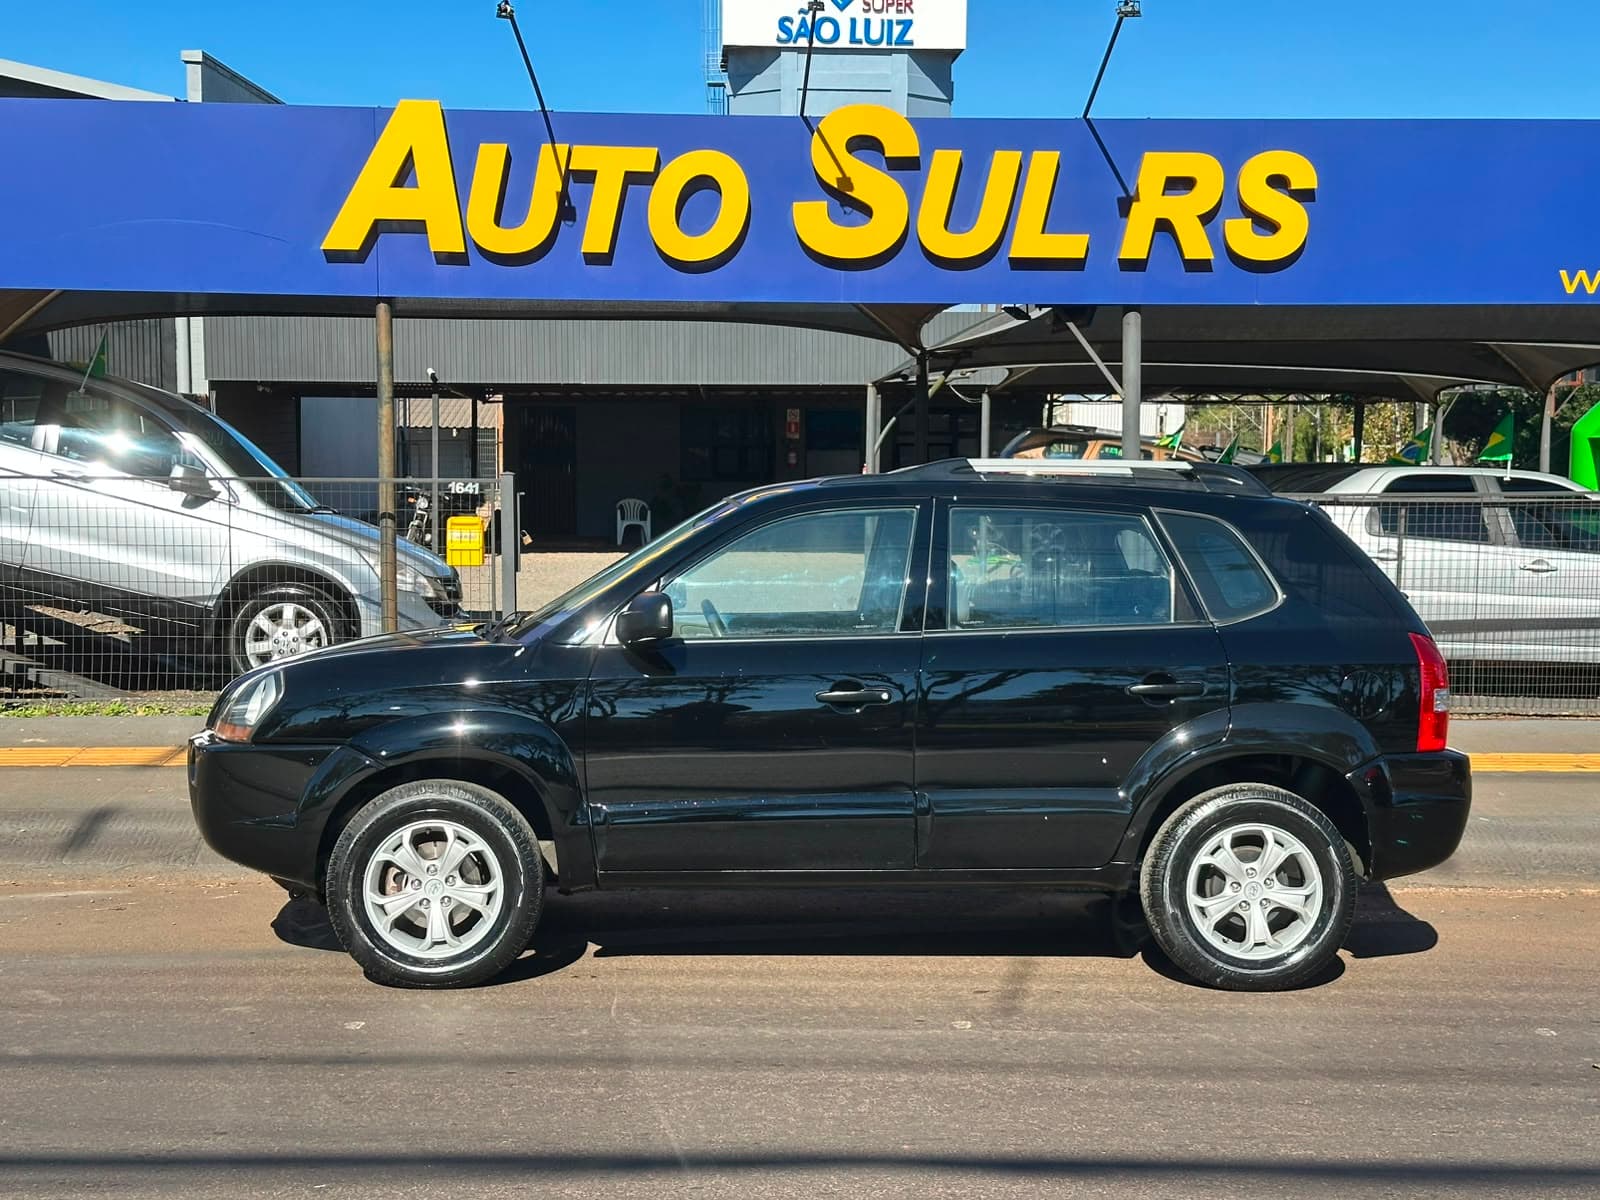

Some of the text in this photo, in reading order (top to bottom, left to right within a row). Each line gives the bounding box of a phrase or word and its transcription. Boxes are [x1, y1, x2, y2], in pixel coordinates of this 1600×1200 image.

[862, 0, 914, 14] SUPER
[776, 8, 914, 46] SÃO LUIZ
[320, 99, 751, 264] AUTO
[447, 481, 480, 494] 1641
